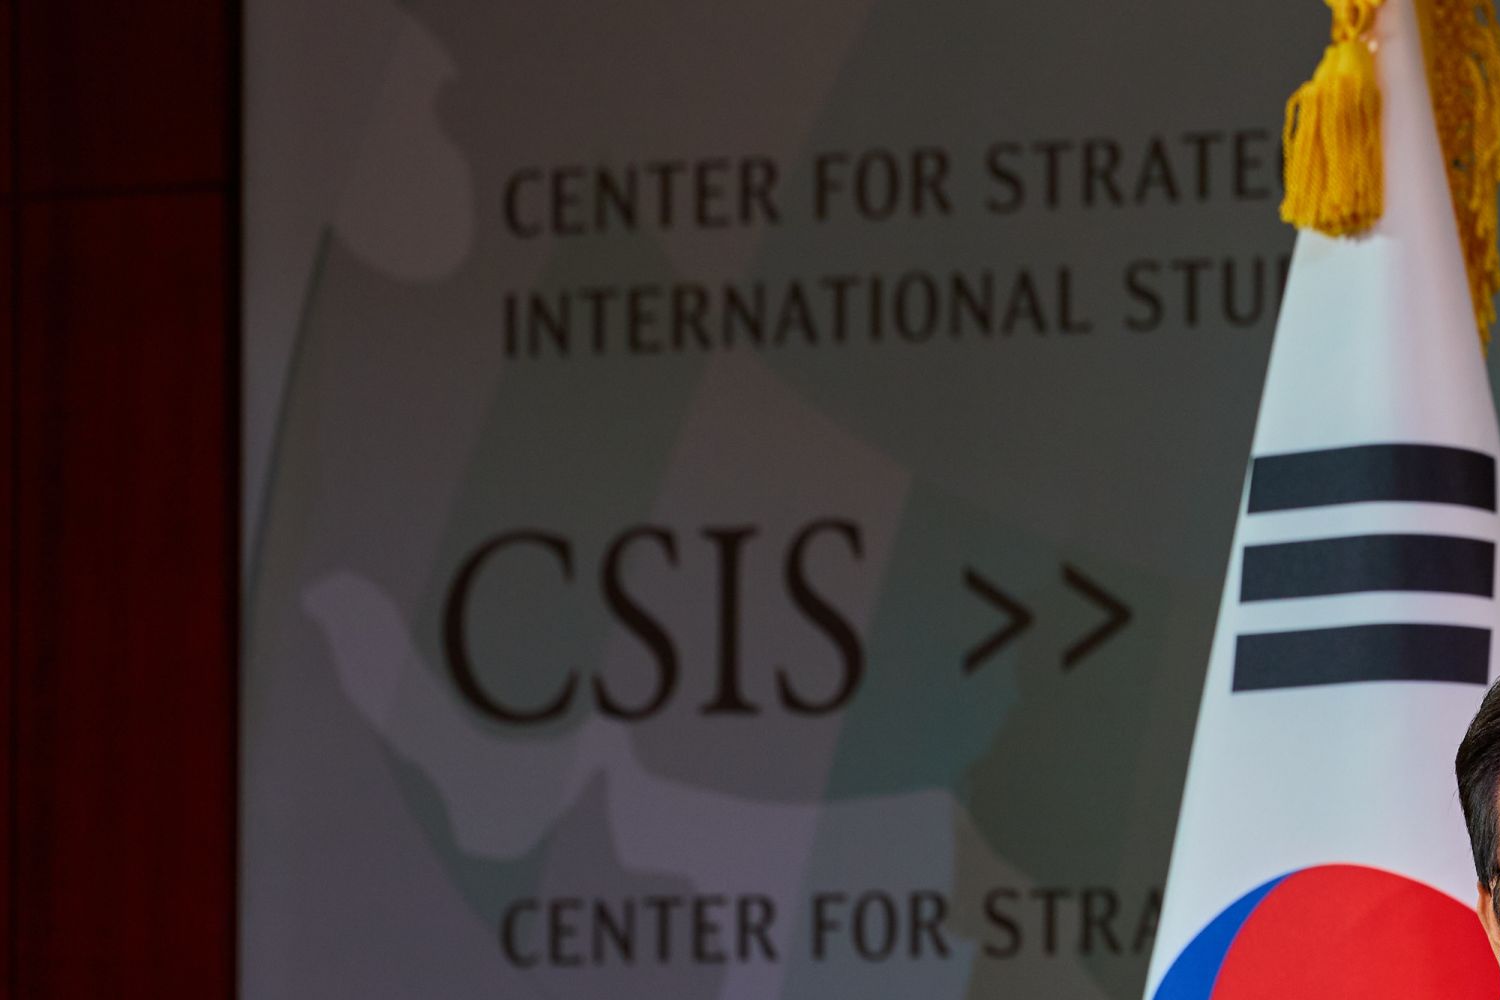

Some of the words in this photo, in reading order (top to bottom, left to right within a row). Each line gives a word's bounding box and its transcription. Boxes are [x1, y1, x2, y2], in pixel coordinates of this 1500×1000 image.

[501, 154, 783, 240] CENTER
[812, 145, 954, 223] FOR
[984, 127, 1285, 215] STRATE
[502, 264, 1093, 360] INTERNATIONAL
[1122, 253, 1291, 333] STU
[441, 518, 866, 726] CSIS
[499, 893, 780, 969] CENTER
[810, 889, 953, 962] FOR
